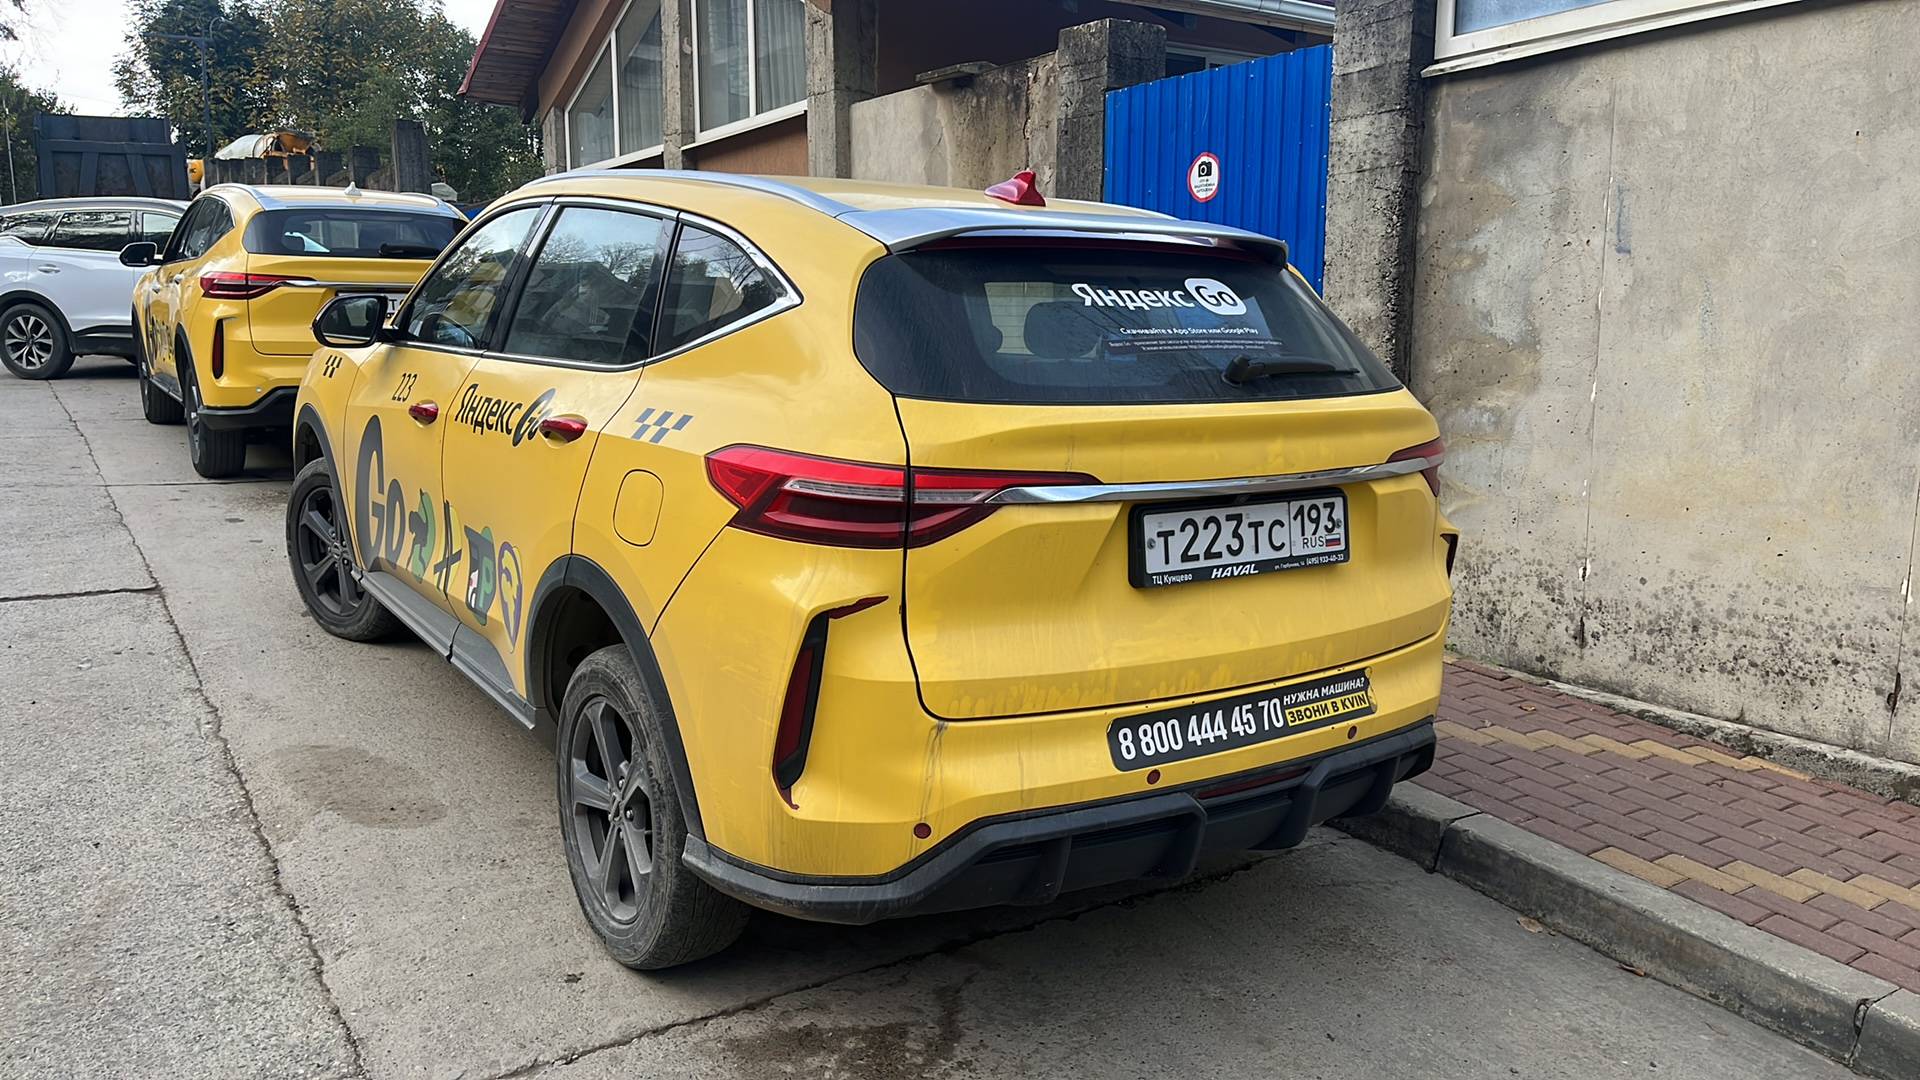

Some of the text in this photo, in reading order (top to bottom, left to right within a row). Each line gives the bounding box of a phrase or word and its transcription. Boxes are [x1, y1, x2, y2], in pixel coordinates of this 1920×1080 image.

[1071, 283, 1241, 311] Яндекс Go
[1119, 327, 1167, 335] Скачивайте
[1173, 327, 1188, 336] App
[1188, 327, 1208, 335] Store
[392, 372, 418, 403] 223
[454, 383, 523, 436] Яндекс
[1292, 501, 1336, 537] 193
[1302, 535, 1325, 549] RUS
[1211, 563, 1260, 580] HAVAL
[1306, 556, 1319, 566] (495)
[1152, 573, 1193, 585] ТЦ Кунцево
[1283, 677, 1365, 706] НУЖНА МАШИНА?
[1288, 697, 1367, 724] ЗВОНИ В KVIN
[1118, 697, 1284, 760] 8 800 444 45 70
